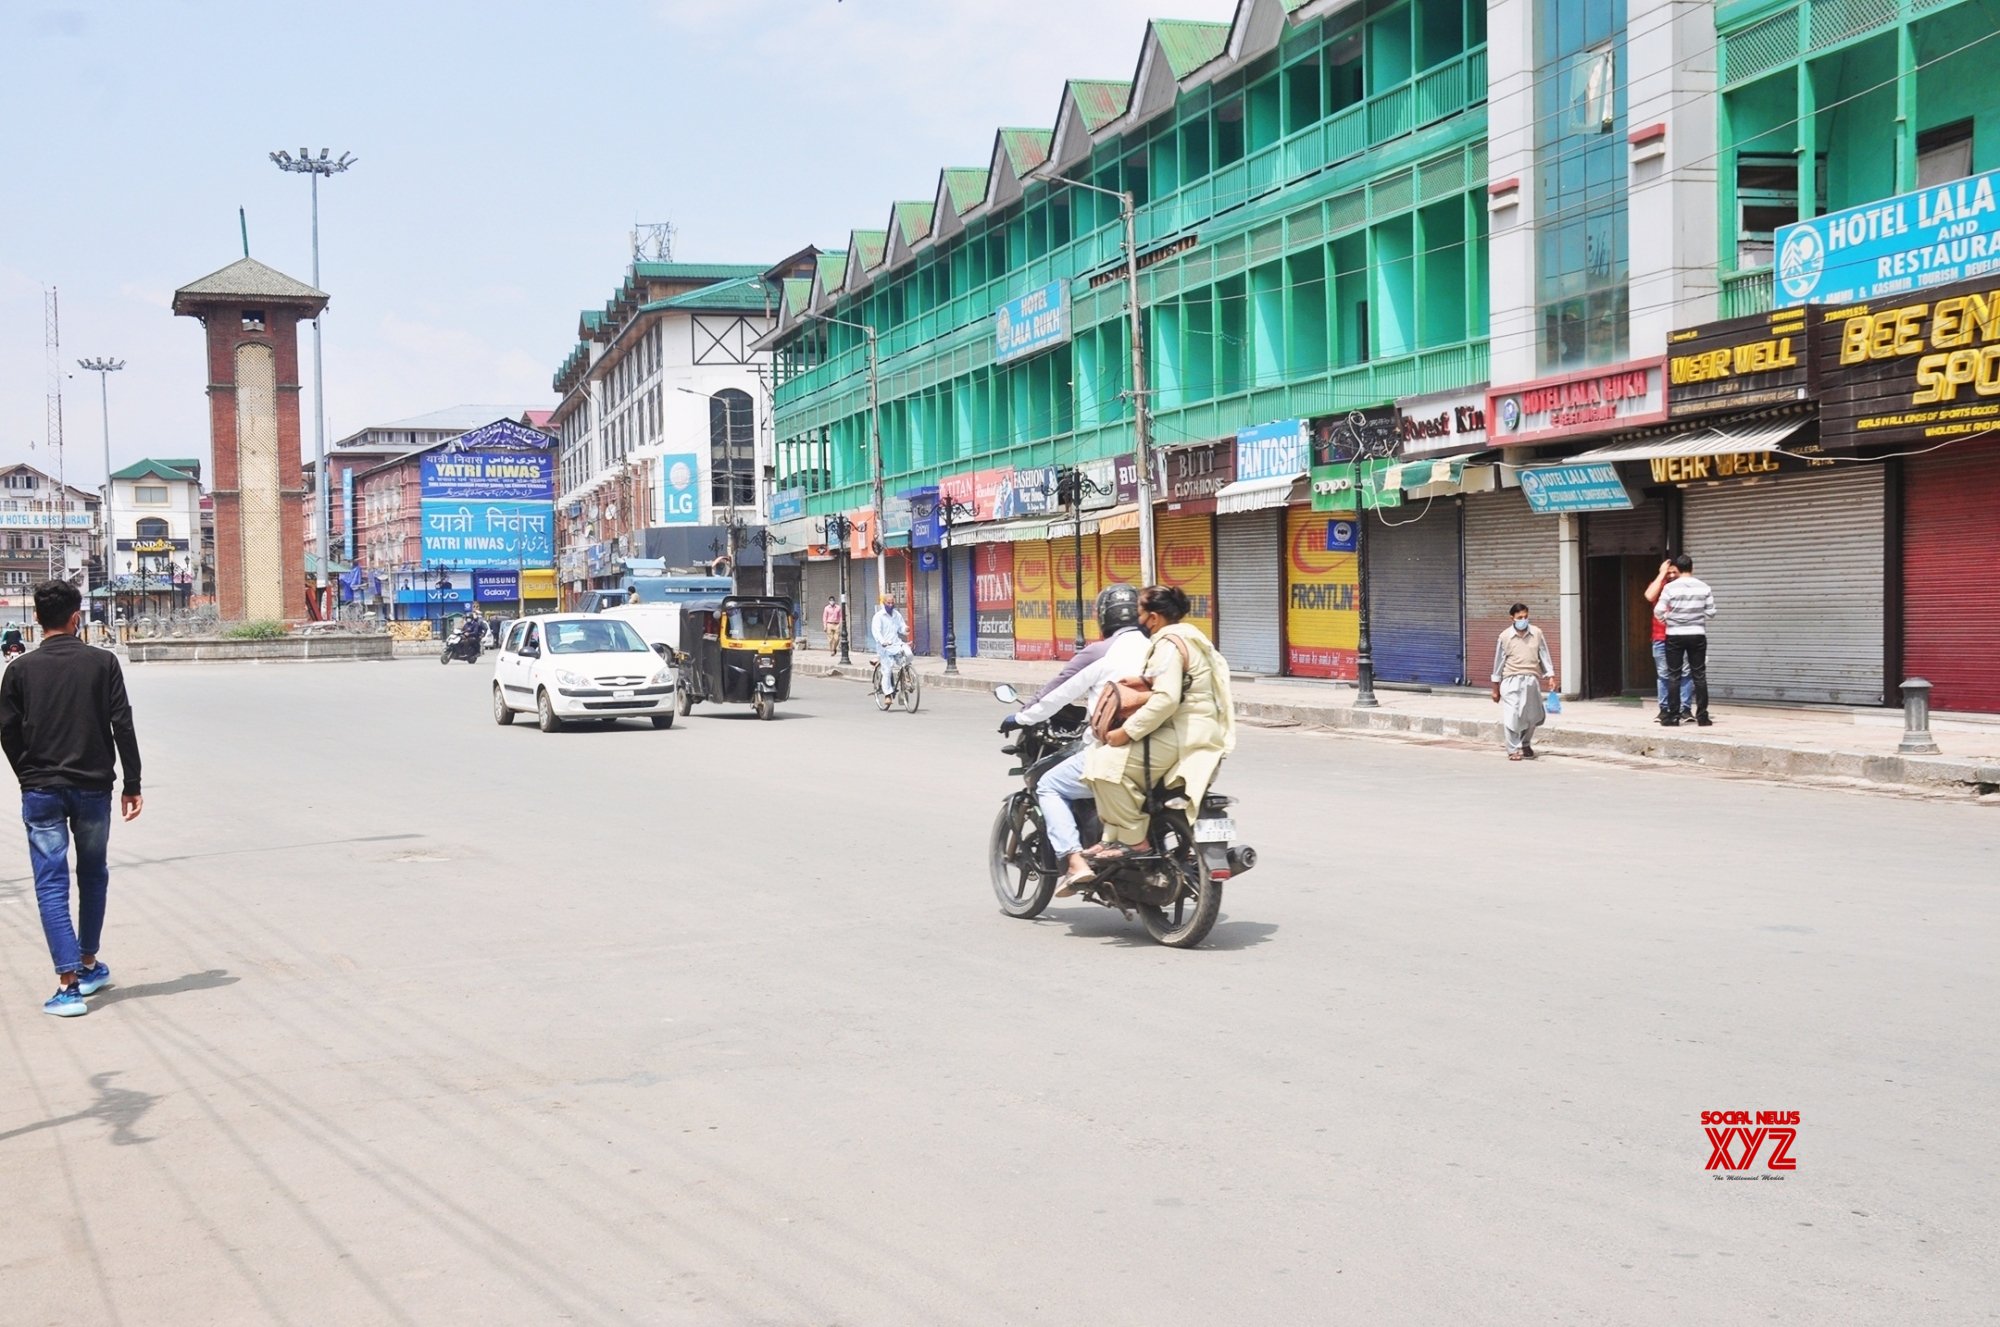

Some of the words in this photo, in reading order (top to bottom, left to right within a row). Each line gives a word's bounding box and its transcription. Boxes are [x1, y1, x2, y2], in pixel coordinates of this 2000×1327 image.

[1829, 204, 1908, 251] HOTEL
[1918, 177, 1997, 229] LALA
[1937, 220, 1979, 242] AND
[1877, 230, 2000, 280] RESTAURA
[1917, 266, 1959, 287] TOURISM
[1021, 288, 1048, 316] HOTEL
[1010, 324, 1031, 347] LALA
[1033, 311, 1061, 336] RUKH
[1840, 304, 1929, 366] BEE
[1670, 348, 1731, 385] WEAR
[1733, 337, 1797, 375] WELL
[1522, 386, 1560, 416] HOTEL
[1560, 378, 1601, 407] LALA
[1601, 369, 1648, 402] RUKH
[1401, 411, 1450, 442] Forest
[435, 463, 482, 478] YATRI
[485, 464, 541, 479] NIWAS
[1178, 450, 1216, 479] BUTT
[1650, 455, 1710, 483] WEAR
[1714, 451, 1780, 477] WELL
[1013, 469, 1045, 488] FASHION
[1313, 478, 1351, 496] oppo
[1539, 471, 1567, 487] HOTEL
[1564, 468, 1589, 485] LALA
[1590, 465, 1620, 483] RUKH
[948, 477, 973, 500] TITAN
[1174, 480, 1200, 498] CLOTH
[1200, 477, 1225, 496] HOUSE
[669, 493, 693, 514] LG
[7, 514, 30, 525] HOTEL
[34, 514, 40, 524] &
[429, 506, 474, 532] यात्री
[485, 506, 546, 533] निवास
[425, 536, 460, 550] YATRI
[464, 536, 505, 550] NIWAS
[1170, 545, 1206, 567] RUPA
[428, 592, 459, 600] vivo
[483, 588, 511, 597] Galaxy
[976, 572, 1012, 602] TITAN
[978, 614, 1013, 634] fastrack
